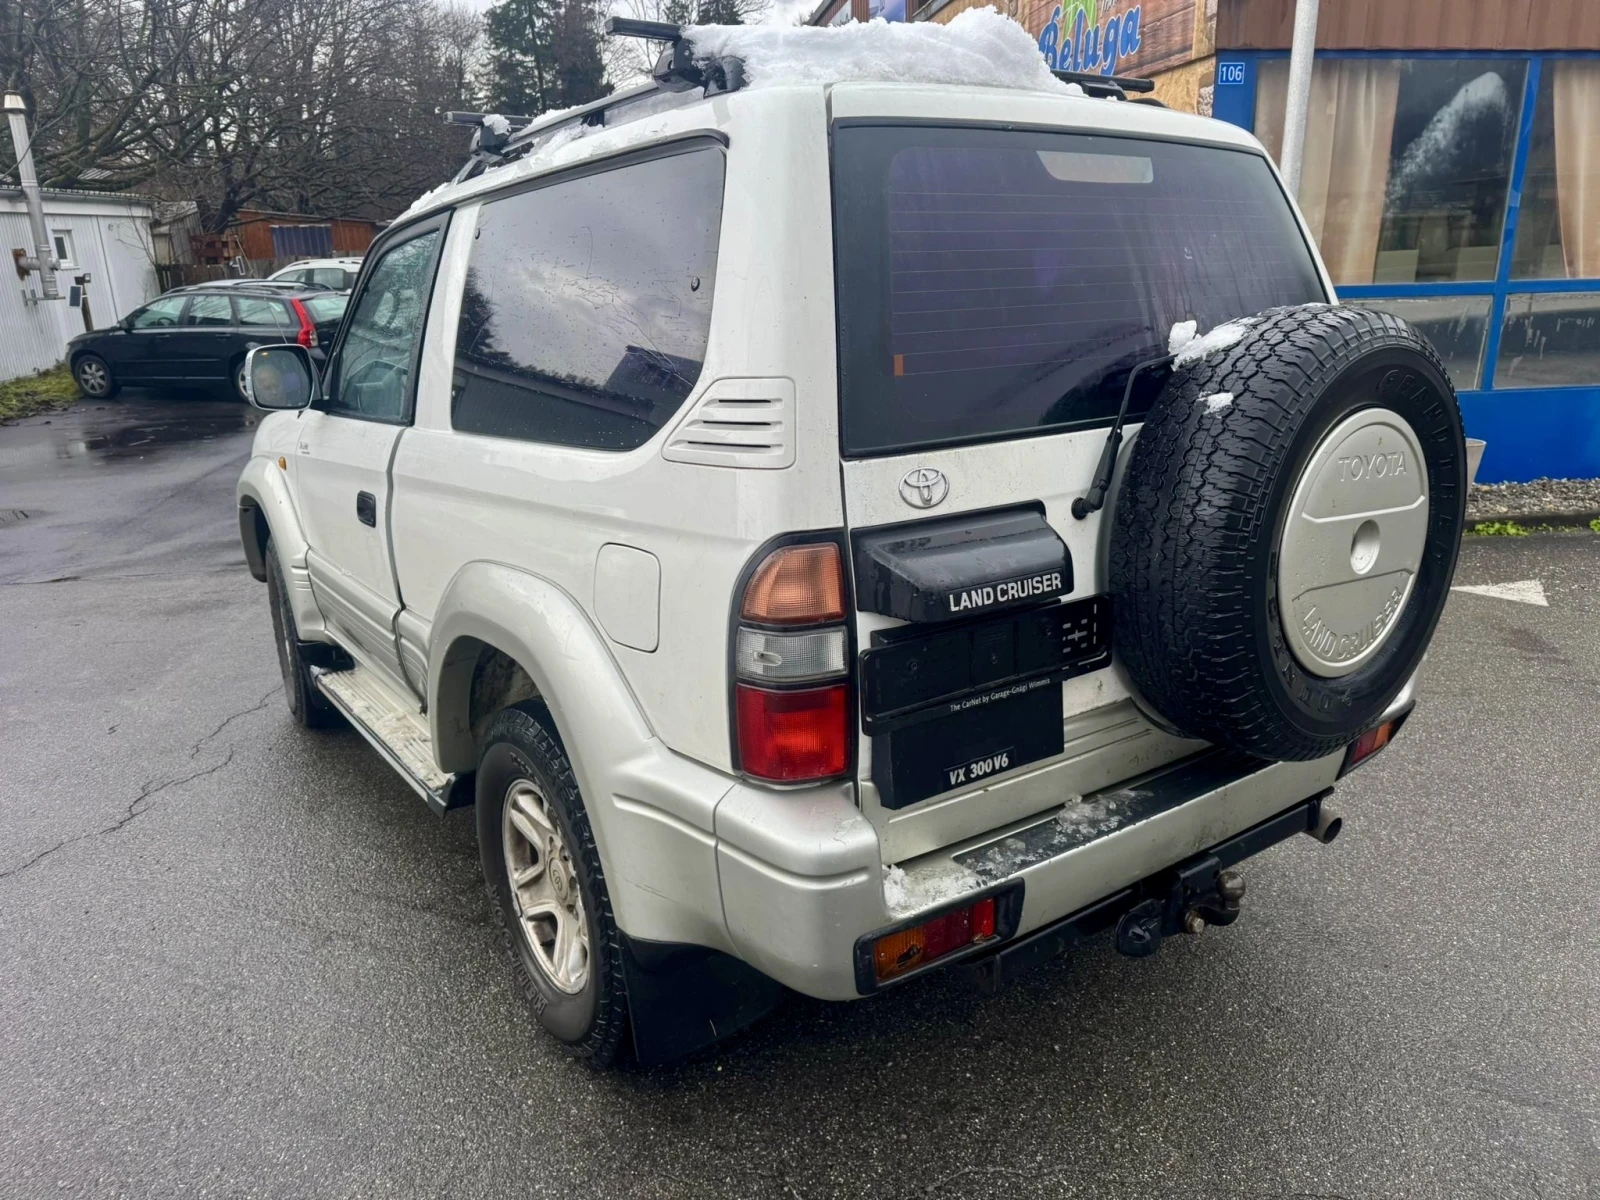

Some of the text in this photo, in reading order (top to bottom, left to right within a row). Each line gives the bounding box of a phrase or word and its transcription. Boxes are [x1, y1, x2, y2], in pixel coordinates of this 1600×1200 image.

[1038, 4, 1142, 77] Beluga
[1220, 65, 1243, 82] 106
[1337, 451, 1408, 482] TOYOTA
[949, 573, 1061, 612] LAND CRUISER
[1301, 604, 1338, 658] LAND
[1336, 587, 1403, 660] CRUISER
[950, 704, 961, 712] The
[962, 696, 982, 709] CarNet
[949, 767, 966, 785] VX
